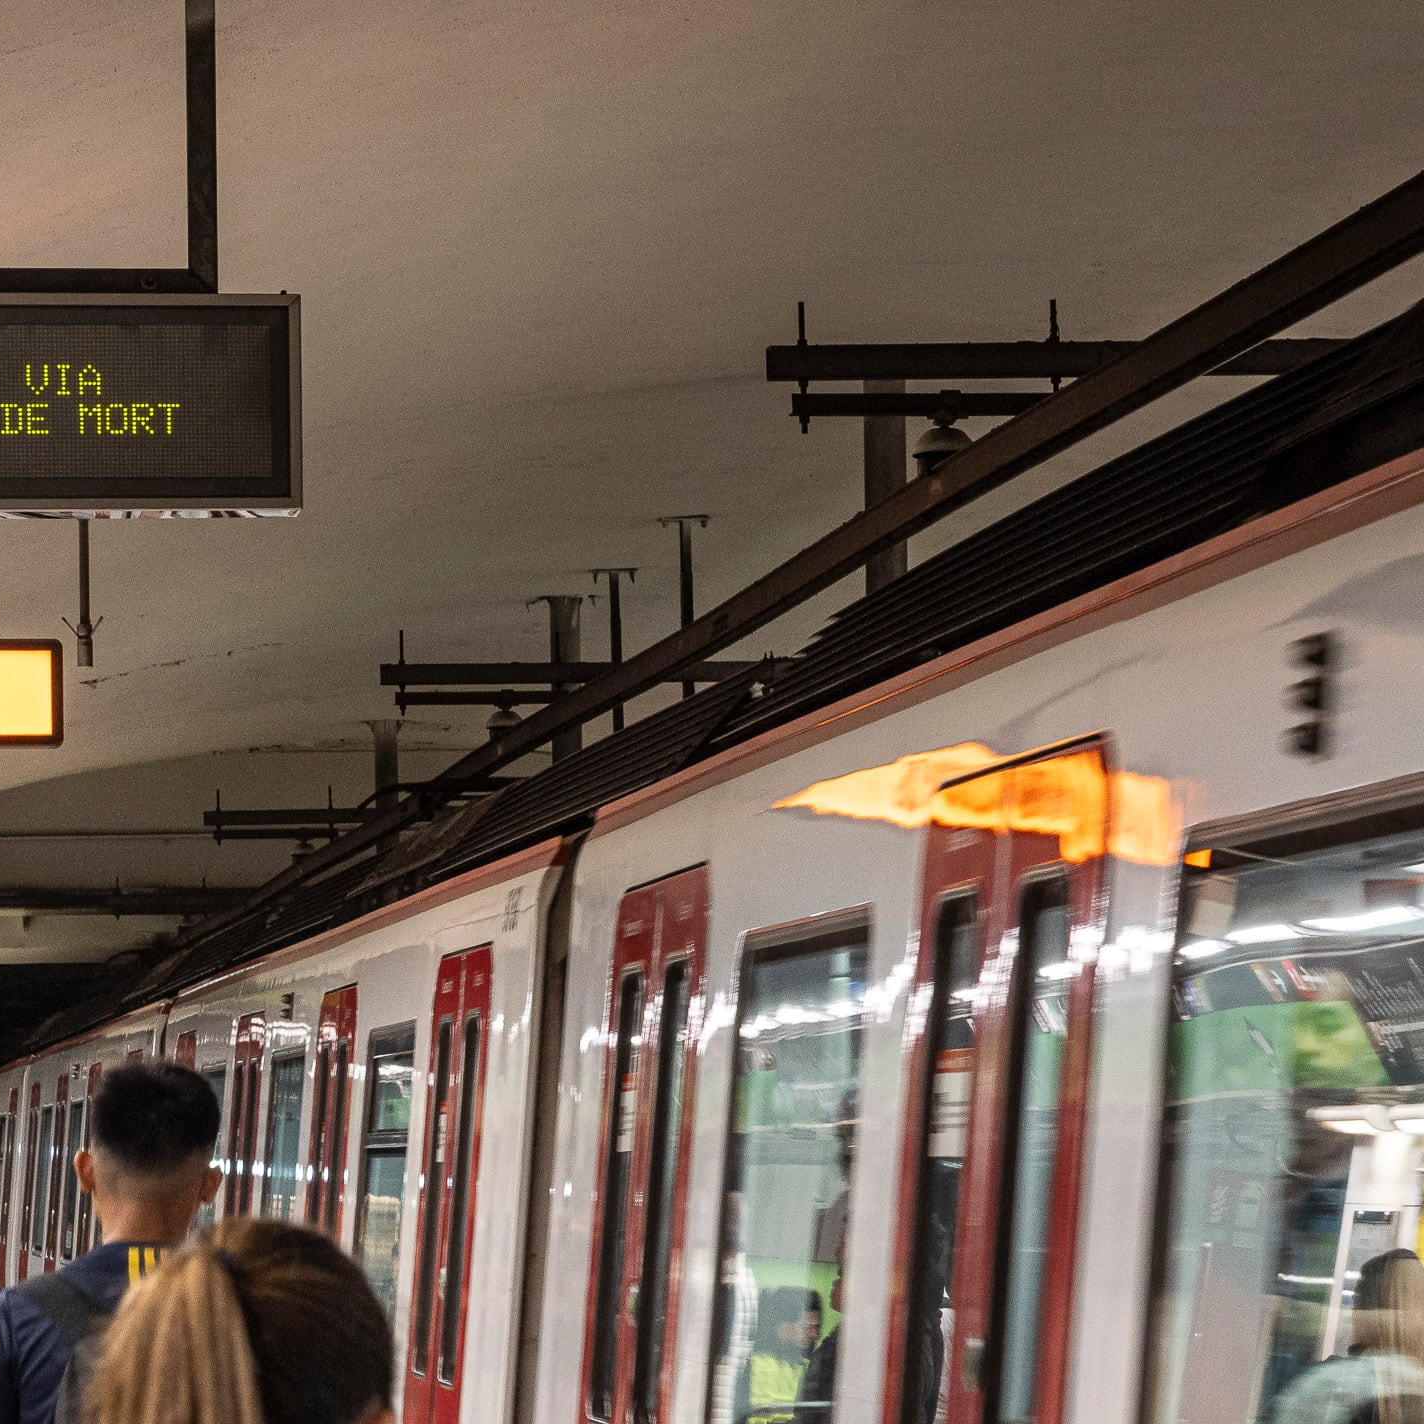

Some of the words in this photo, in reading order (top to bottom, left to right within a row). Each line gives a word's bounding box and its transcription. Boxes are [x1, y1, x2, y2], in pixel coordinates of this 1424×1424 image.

[25, 364, 102, 396] VIA
[0, 403, 50, 435] DE
[78, 403, 181, 435] MORT
